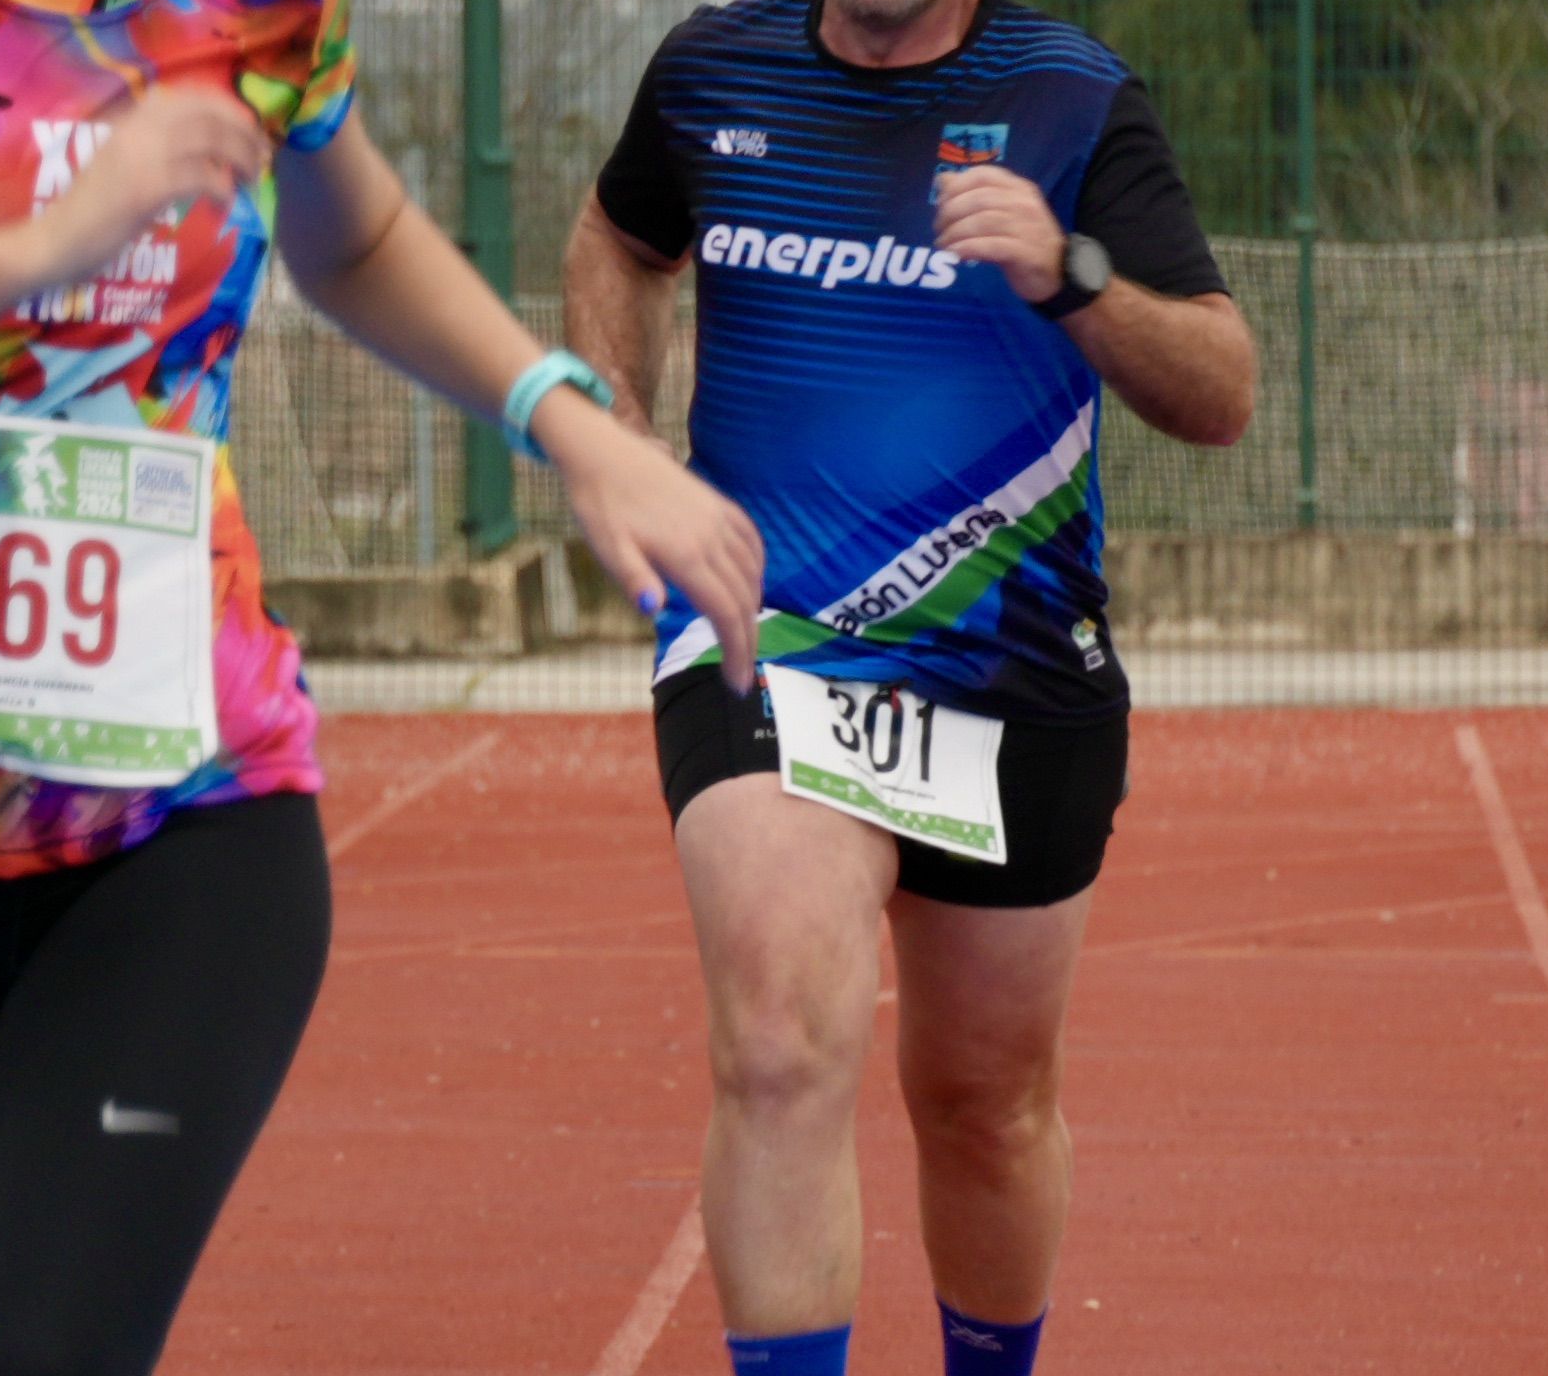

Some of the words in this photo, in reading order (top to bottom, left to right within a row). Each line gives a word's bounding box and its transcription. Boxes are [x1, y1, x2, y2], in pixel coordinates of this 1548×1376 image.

[735, 141, 768, 158] PRO
[702, 224, 961, 289] enerplus
[828, 682, 937, 782] 301
